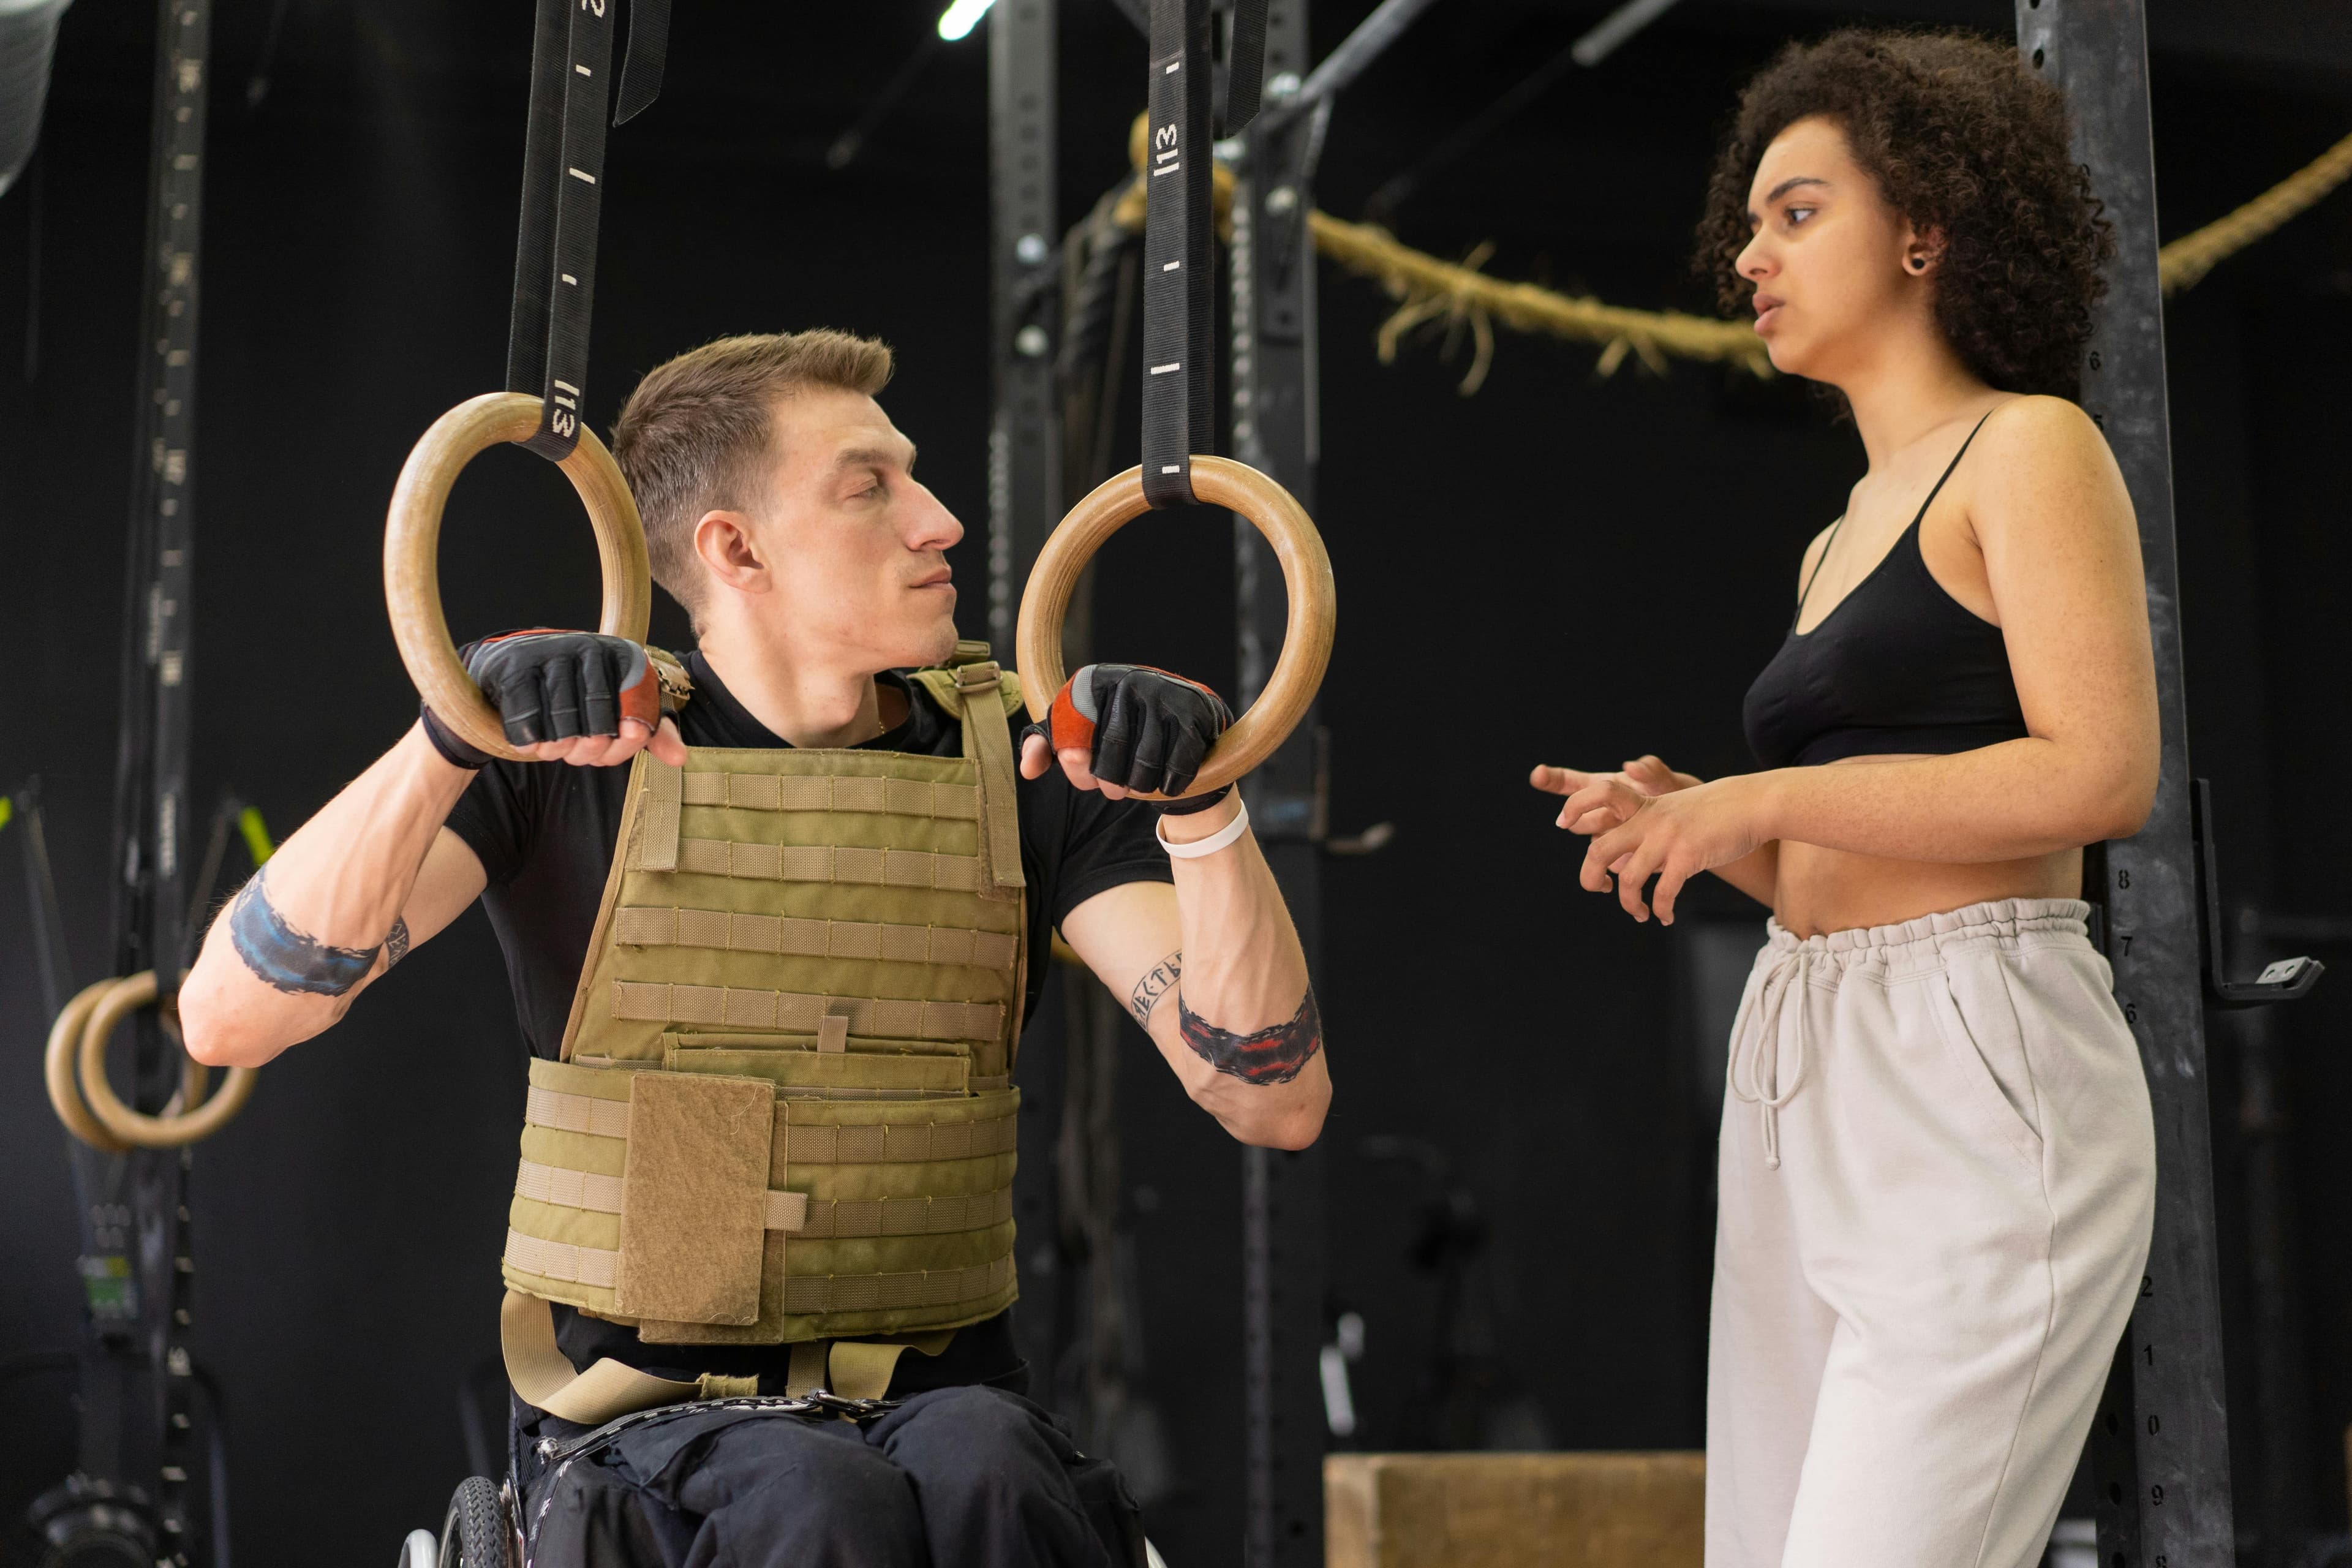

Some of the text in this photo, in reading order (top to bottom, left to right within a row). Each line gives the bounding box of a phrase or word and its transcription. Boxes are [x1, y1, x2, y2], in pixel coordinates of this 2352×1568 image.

[2089, 350, 2101, 371] 6
[2118, 869, 2130, 889] 8
[2120, 937, 2133, 957] 7
[2125, 1003, 2137, 1024] 6
[2140, 1276, 2153, 1297] 2
[2143, 1344, 2154, 1366] 1
[2147, 1414, 2160, 1436] 0
[2150, 1484, 2163, 1506] 9
